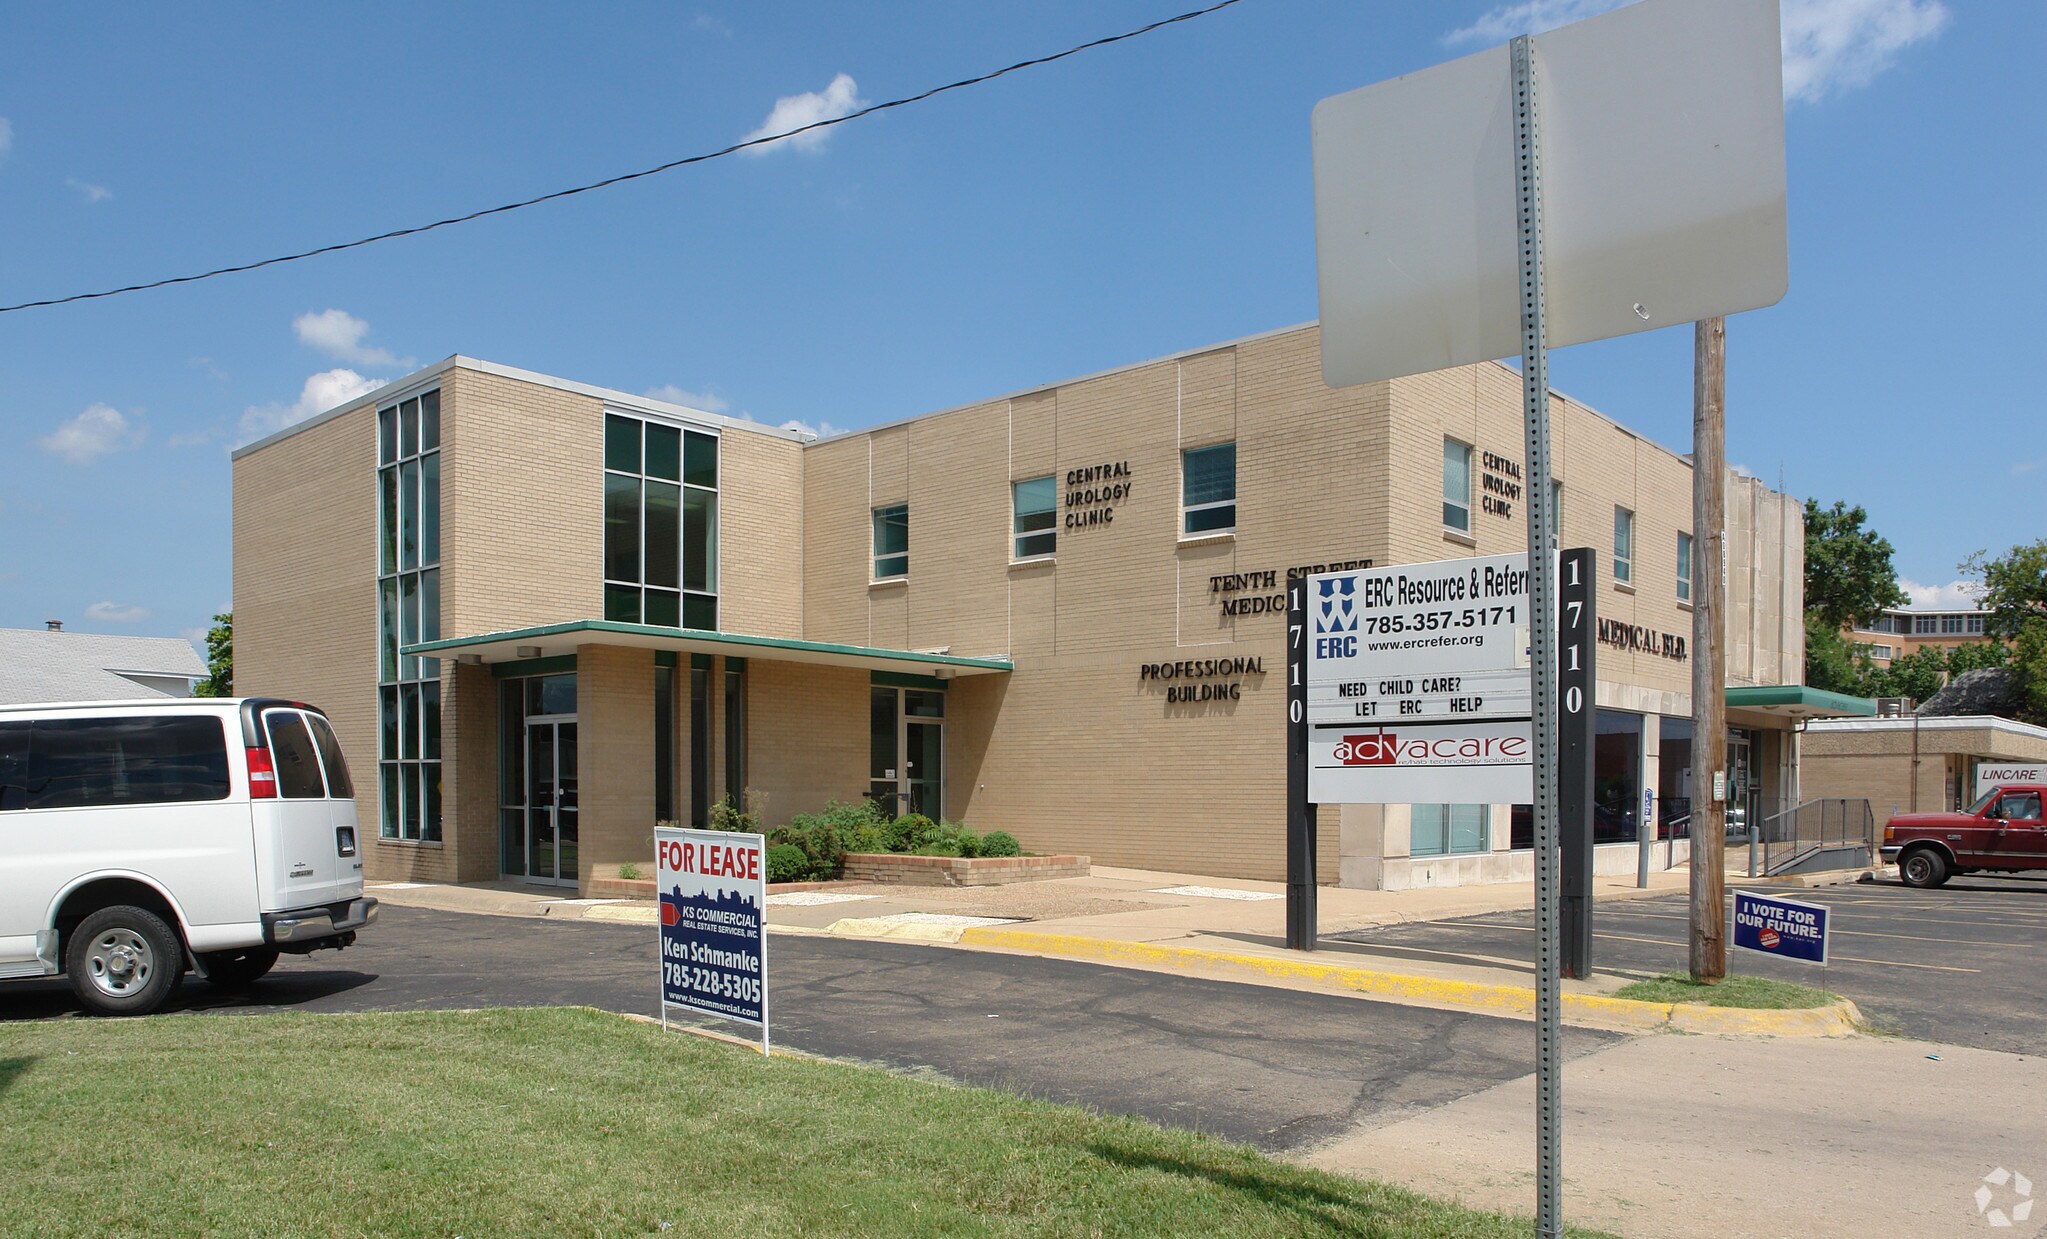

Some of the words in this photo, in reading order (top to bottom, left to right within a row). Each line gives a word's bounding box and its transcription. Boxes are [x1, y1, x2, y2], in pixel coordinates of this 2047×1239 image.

[1067, 461, 1131, 486] CENTRAL
[1483, 450, 1522, 480] CENTRAL
[1066, 483, 1131, 507] UROLOGY
[1483, 472, 1521, 501] UROLOGY
[1065, 507, 1113, 528] CLINIC
[1482, 495, 1512, 519] CLINIC
[1210, 570, 1277, 592] TENTH
[1365, 576, 1394, 608] ERC
[1398, 575, 1465, 606] Resource
[1469, 567, 1480, 600] &
[1222, 594, 1287, 616] MEDIC
[1365, 605, 1516, 635] 785-357-5171
[1316, 635, 1358, 660] ERC
[1368, 634, 1484, 652] www.ercrefer.org
[1598, 616, 1660, 654] MEDICAL
[1141, 656, 1267, 680] PROFESSIONAL
[1167, 683, 1241, 703] BUILDING
[1339, 683, 1367, 697] NEED
[1379, 679, 1414, 695] CHILD
[1422, 677, 1461, 693] CARE?
[1355, 701, 1377, 716] LET
[1400, 700, 1422, 714] ERC
[1450, 697, 1483, 712] HELP
[1333, 727, 1527, 761] advacare
[1982, 769, 2038, 780] LINCARE
[659, 840, 695, 873] FOR
[699, 844, 759, 880] LEASE
[682, 905, 695, 919] KS
[696, 907, 758, 928] COMMERCIAL
[1736, 912, 1764, 929] OUR
[1766, 918, 1822, 939] FUTURE.
[1743, 901, 1749, 913] I
[1751, 903, 1785, 920] VOTE
[1787, 909, 1815, 926] FOR
[682, 919, 697, 929] REAL
[697, 922, 718, 933] ESTATE
[717, 925, 746, 938] SERVICES,
[746, 929, 759, 939] INC.
[663, 936, 689, 960] Ken
[690, 940, 760, 973] Schmanke
[664, 961, 761, 1003] 785-228-5305
[668, 991, 759, 1018] www.kscommercial.com
